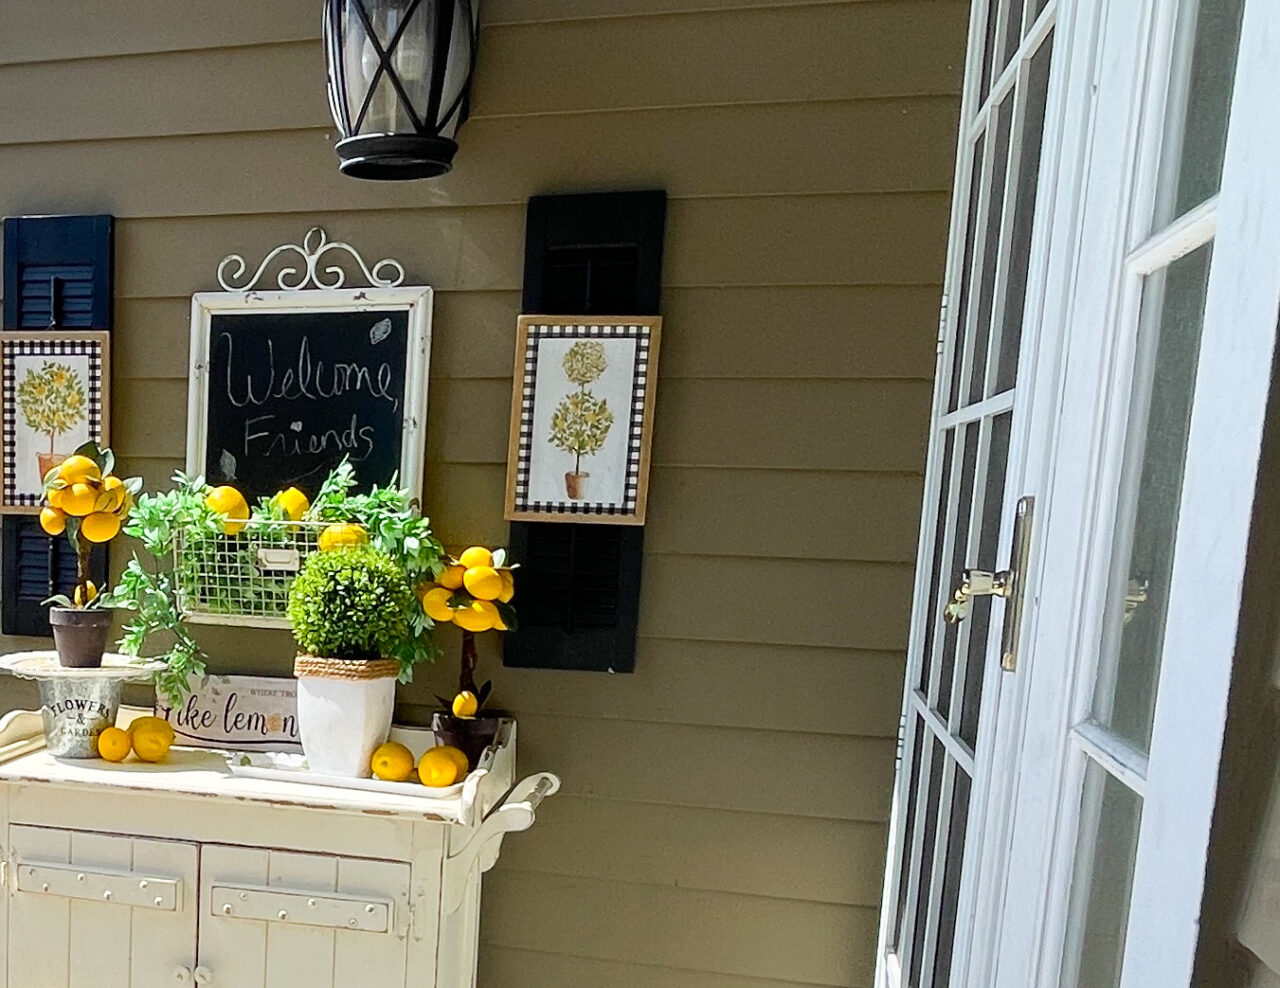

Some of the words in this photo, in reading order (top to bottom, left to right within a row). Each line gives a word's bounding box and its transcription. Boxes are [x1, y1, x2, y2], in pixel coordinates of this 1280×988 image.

[222, 332, 399, 413] Welcome,
[244, 413, 375, 462] Friends
[50, 699, 110, 719] FLOWERS
[76, 712, 86, 726] &
